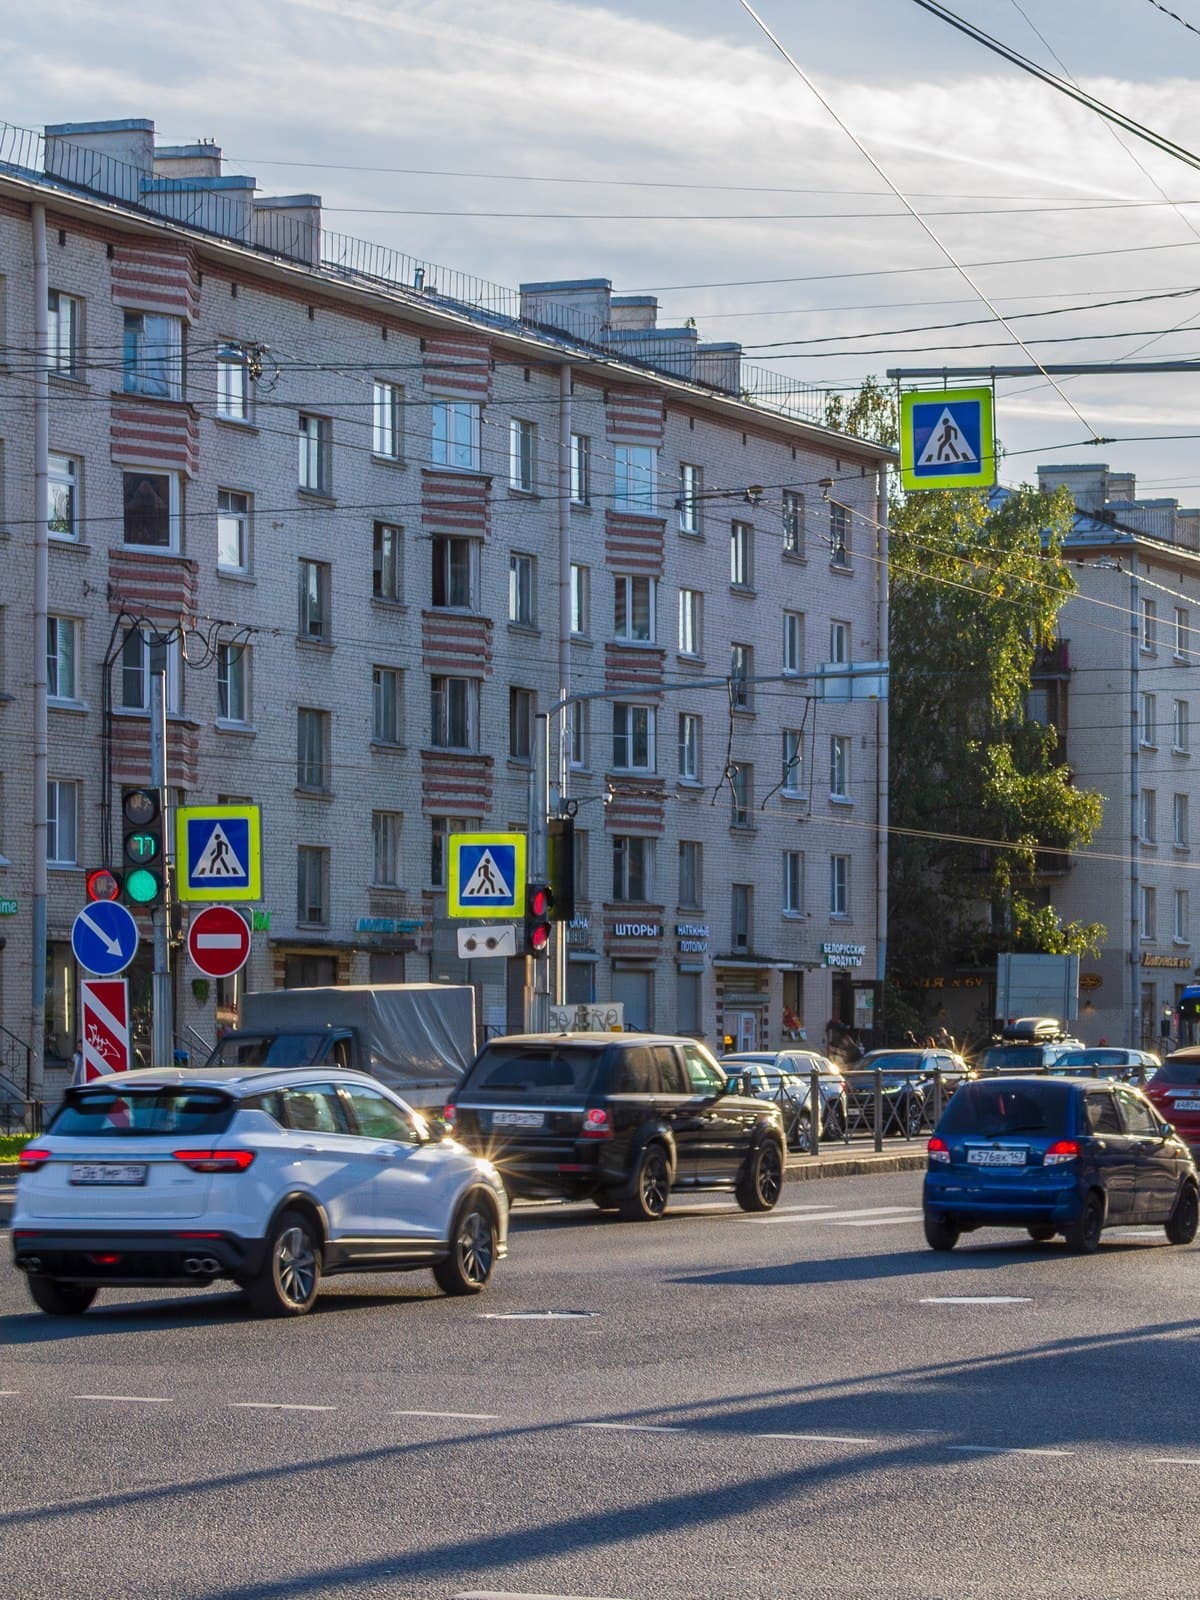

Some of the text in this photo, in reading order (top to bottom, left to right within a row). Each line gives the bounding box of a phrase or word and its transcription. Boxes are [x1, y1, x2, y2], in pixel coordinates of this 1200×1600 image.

[615, 923, 657, 937] ШТОРЫ
[677, 924, 710, 937] НАТЯЖНЫЕ
[680, 940, 708, 953] ПОТОЛКИ
[823, 943, 866, 956] БЕЛОРУССКИЕ
[827, 954, 863, 968] ПРОДУКТЫ
